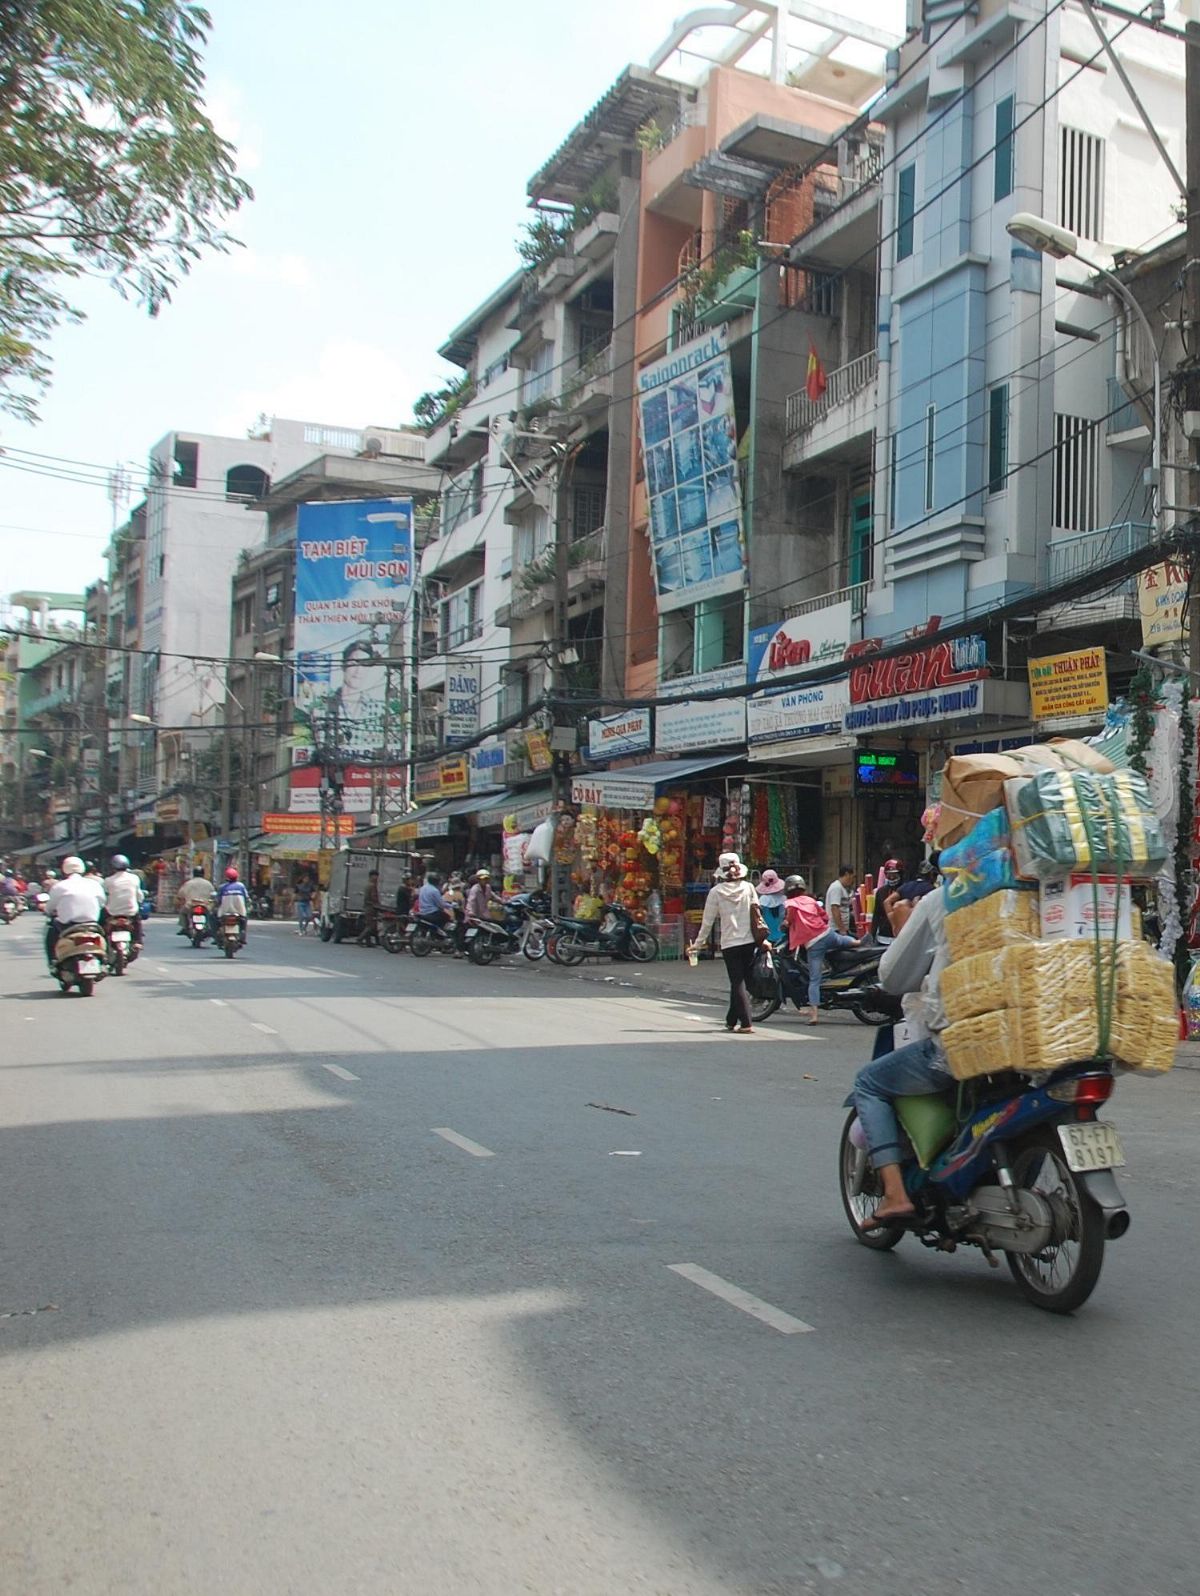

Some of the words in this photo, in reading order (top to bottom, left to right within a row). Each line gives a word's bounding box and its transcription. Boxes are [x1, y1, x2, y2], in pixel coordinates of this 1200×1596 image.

[301, 540, 333, 562] TẠM
[334, 536, 369, 560] BIỆT
[344, 559, 375, 581] MÙI
[377, 558, 410, 579] SƠN
[1144, 569, 1158, 590] 金
[1053, 655, 1078, 675] THUẬN
[1080, 650, 1100, 671] PHÁT
[449, 674, 477, 693] ĐĂNG
[448, 698, 477, 715] KHOA
[781, 693, 798, 708] VĂN
[798, 690, 824, 705] PHÒNG
[844, 705, 878, 730] CHUYÊN
[878, 703, 898, 723] MAY
[911, 697, 938, 719] PHỤC
[938, 691, 962, 714] NAM
[962, 684, 979, 709] NỮ
[1068, 1125, 1108, 1146] 62-F7
[1075, 1146, 1116, 1166] 8197
